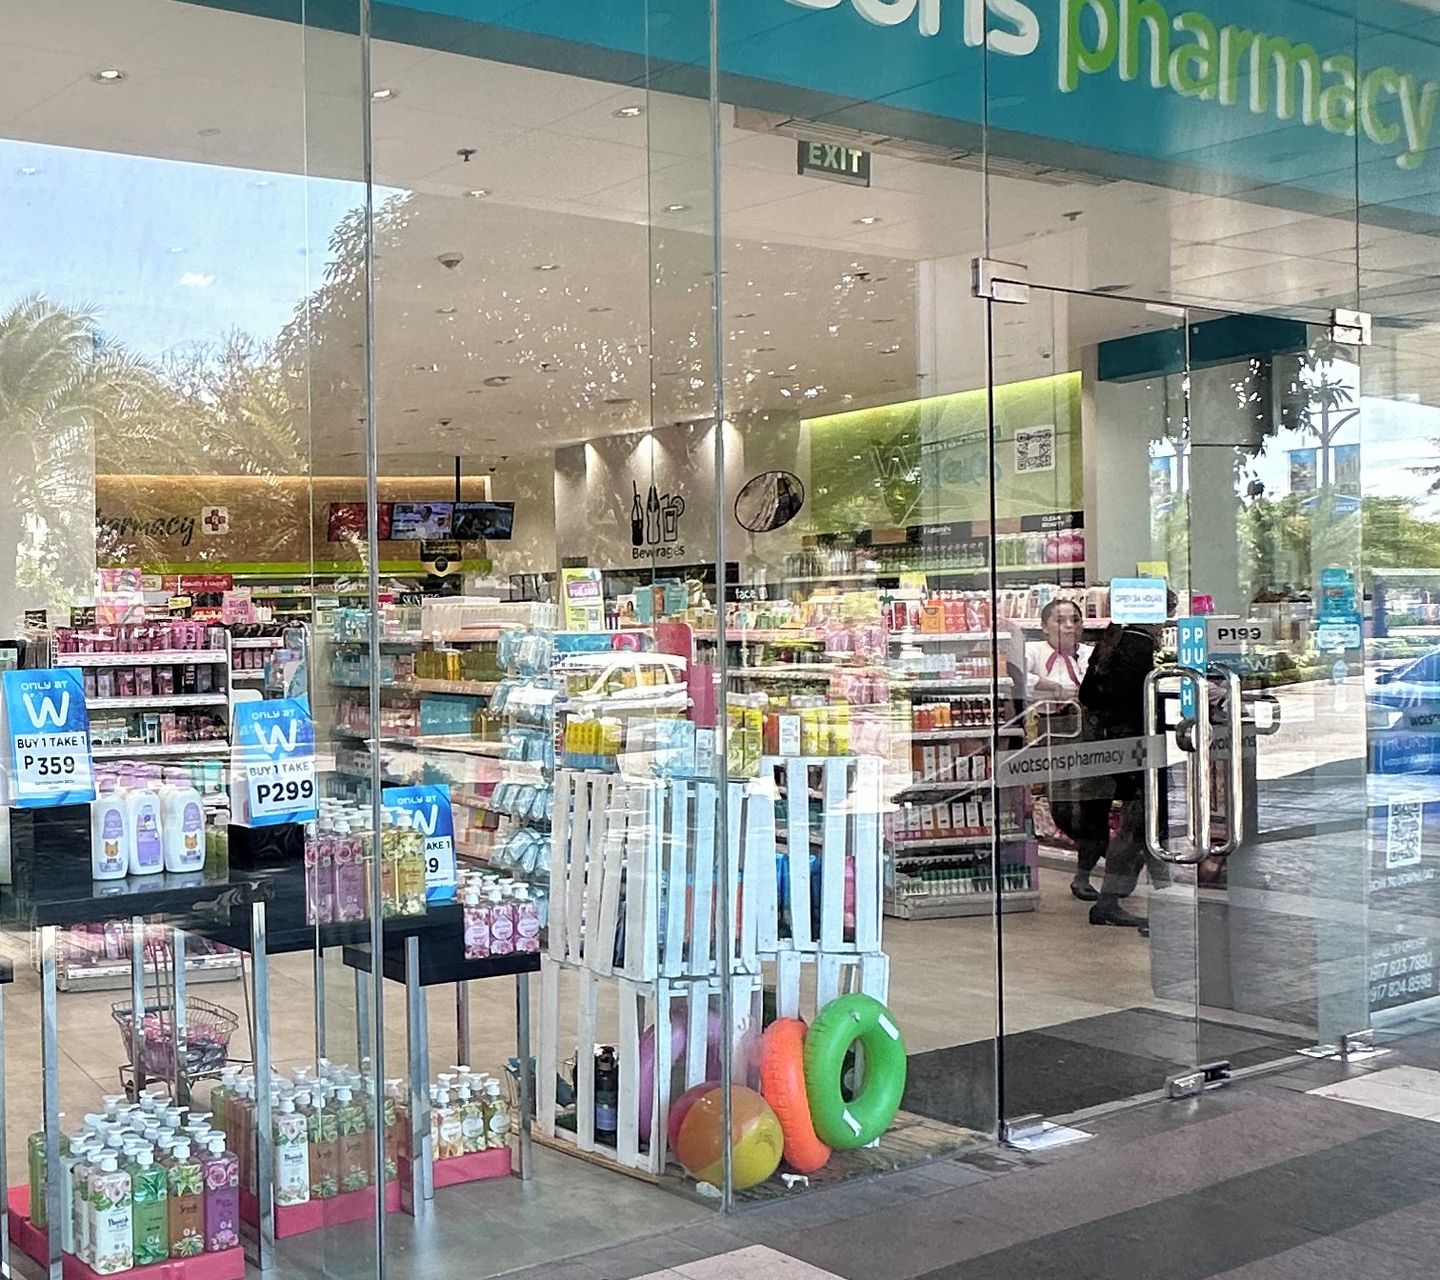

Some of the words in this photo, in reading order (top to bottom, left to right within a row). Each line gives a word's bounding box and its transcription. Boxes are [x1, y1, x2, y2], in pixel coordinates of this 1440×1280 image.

[809, 142, 863, 174] EXIT
[632, 544, 685, 559] Beverages
[1218, 628, 1261, 639] P199
[23, 690, 69, 729] W
[18, 738, 38, 750] BUY
[42, 738, 46, 748] 1
[49, 736, 77, 747] TAKE
[81, 735, 86, 746] 1
[24, 755, 75, 776] P359
[249, 765, 271, 776] BUY
[273, 764, 278, 774] 1
[282, 762, 309, 773] TAKE
[1009, 755, 1066, 774] watsons
[1066, 747, 1124, 769] pharmacy
[257, 779, 313, 804] P299
[426, 840, 445, 851] AKE
